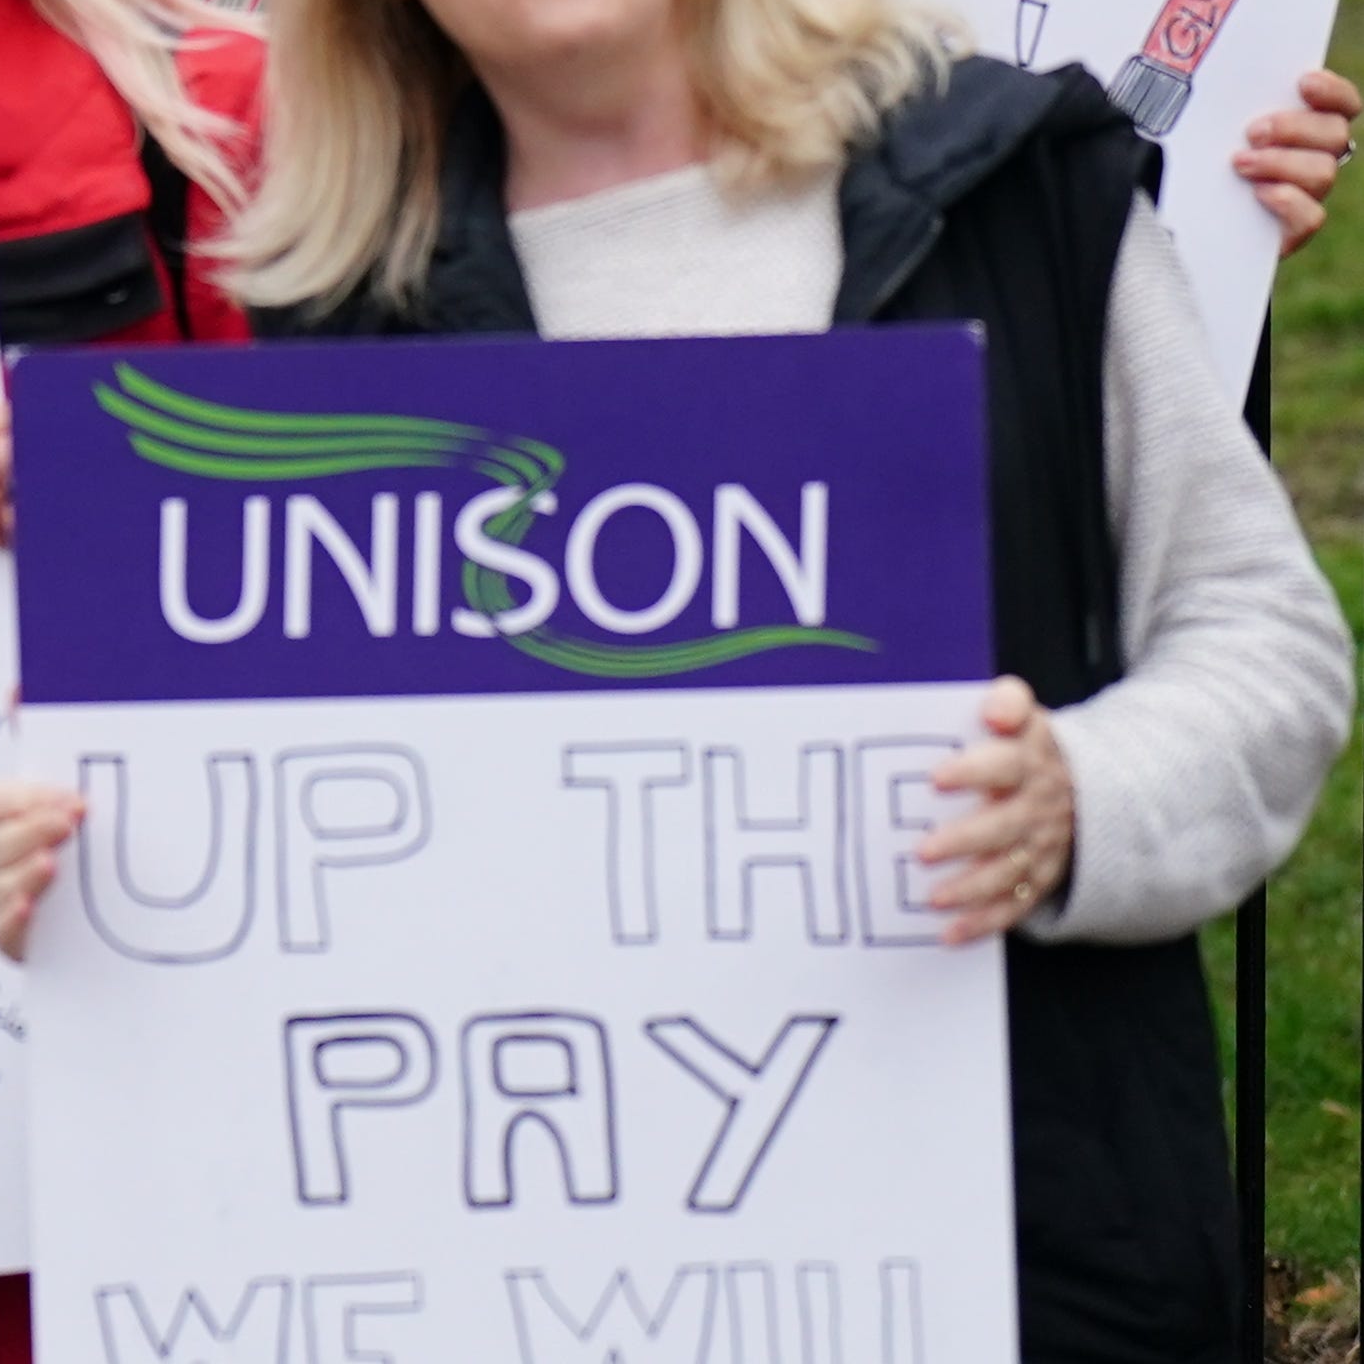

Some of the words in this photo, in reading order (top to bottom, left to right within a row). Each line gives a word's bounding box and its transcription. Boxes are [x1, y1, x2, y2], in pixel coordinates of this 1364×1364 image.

[157, 480, 828, 643] UNISON
[76, 741, 433, 964] UP
[560, 734, 969, 948] THE
[282, 1009, 841, 1213] PAY
